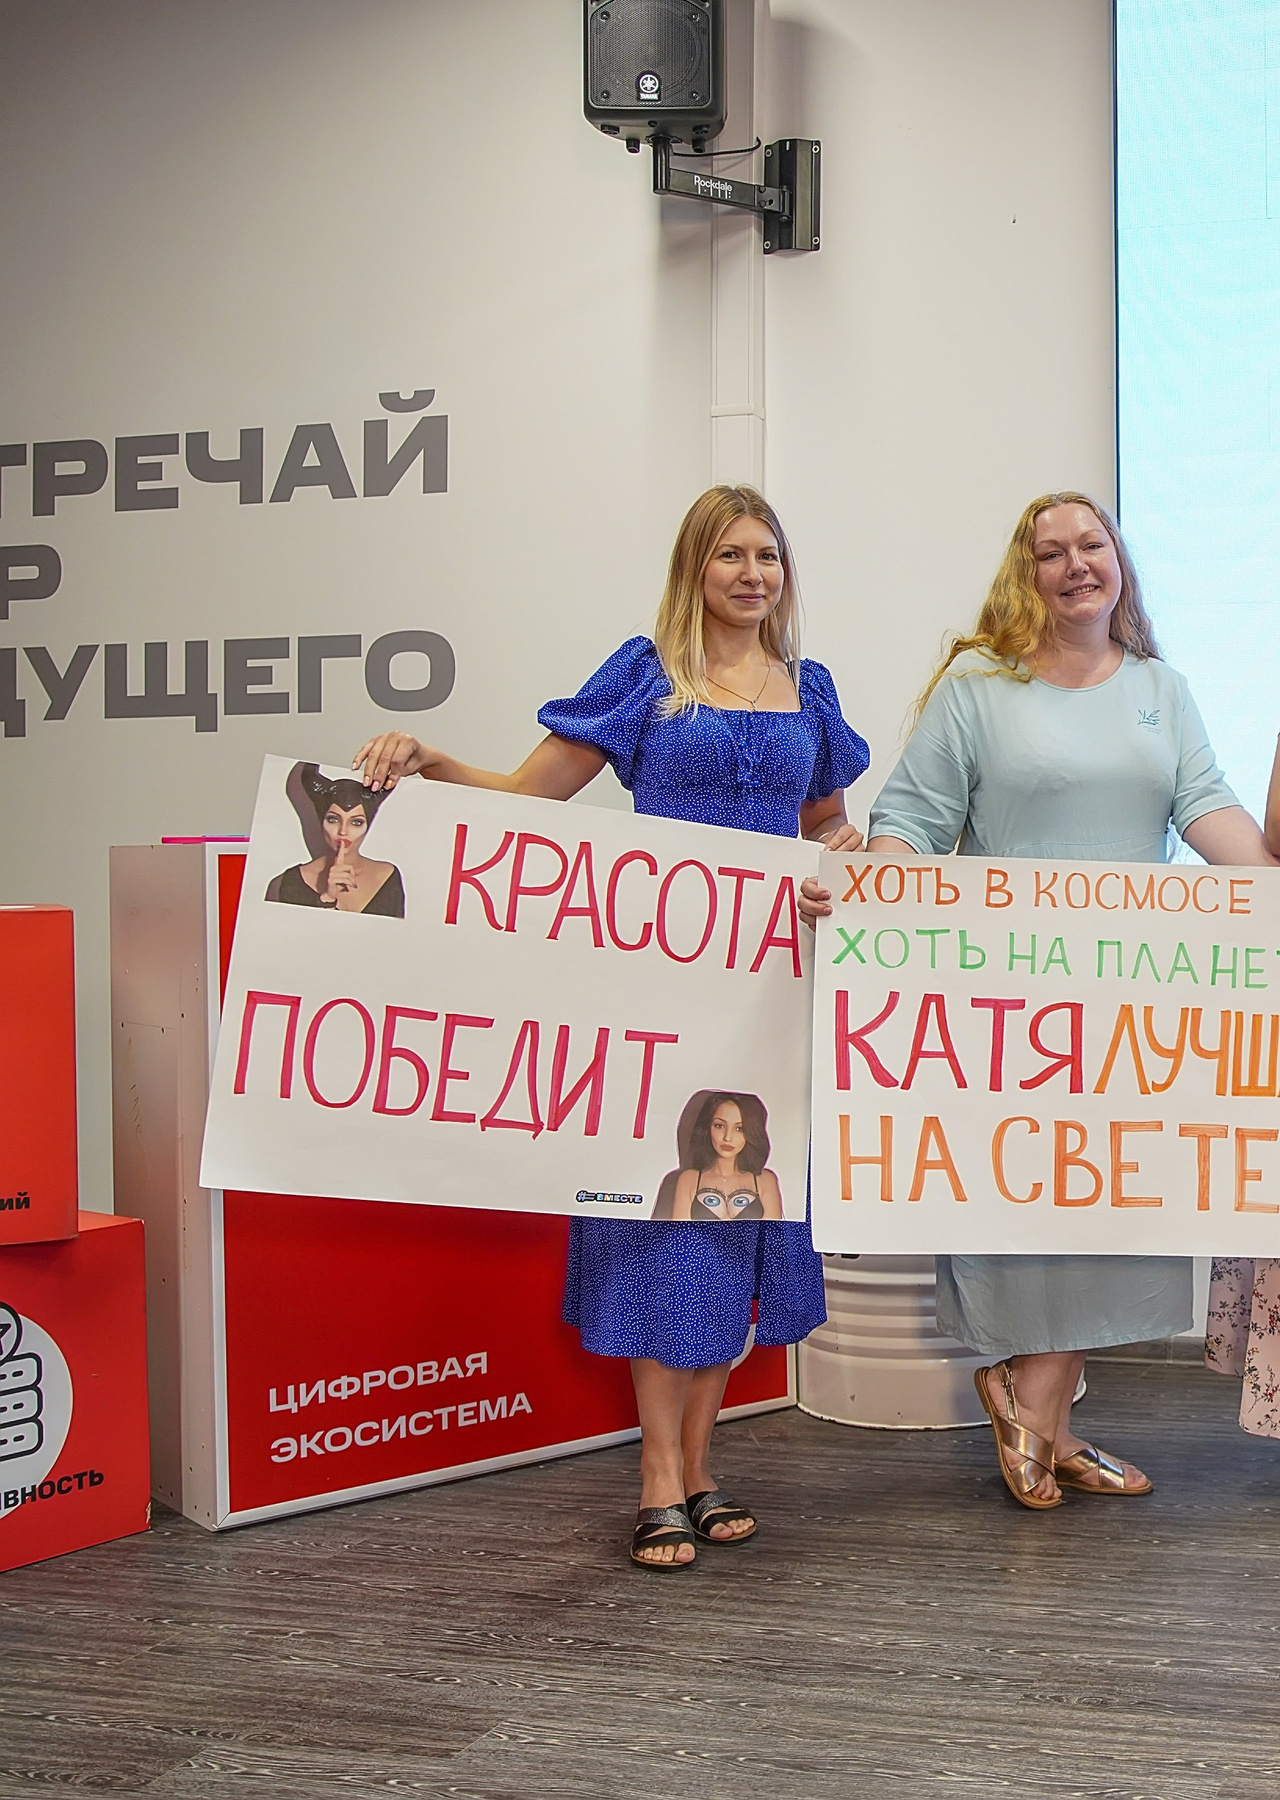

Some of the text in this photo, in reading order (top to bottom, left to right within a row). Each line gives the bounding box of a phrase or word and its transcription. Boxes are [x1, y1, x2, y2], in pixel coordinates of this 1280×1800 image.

[694, 175, 733, 198] Rockdale
[444, 823, 803, 978] КРАСОТА
[840, 863, 1254, 914] ХОТЬ В КОСМОСЕ
[831, 927, 987, 970] ХОТЬ
[1007, 933, 1073, 977] НА
[233, 989, 680, 1141] ПОБЕДИТ
[834, 990, 1084, 1094] КАТЯ
[838, 1114, 968, 1202] НА
[268, 1351, 489, 1414] ЦИФРОВАЯ
[269, 1392, 533, 1464] ЭКОСИСТЕМА
